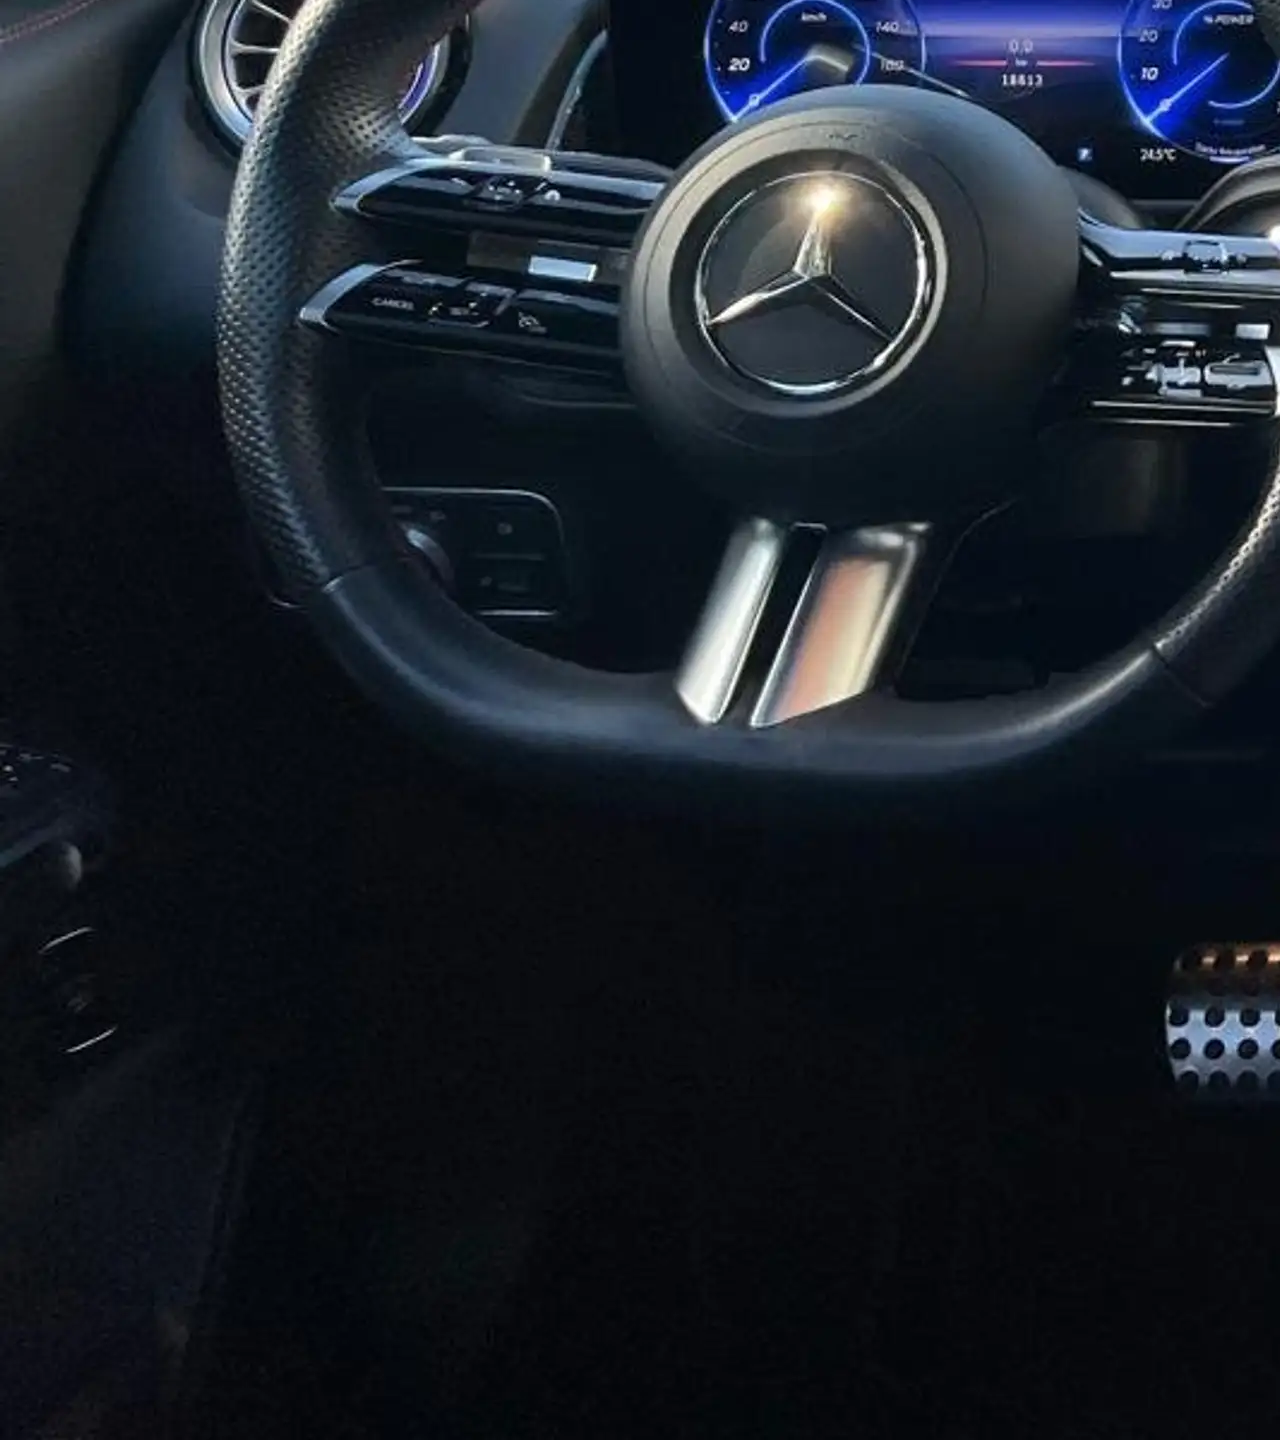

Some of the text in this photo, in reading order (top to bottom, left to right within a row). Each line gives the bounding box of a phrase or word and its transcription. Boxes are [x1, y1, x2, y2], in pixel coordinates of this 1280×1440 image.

[728, 20, 749, 33] 40
[728, 57, 750, 72] 20
[1141, 66, 1159, 81] 10
